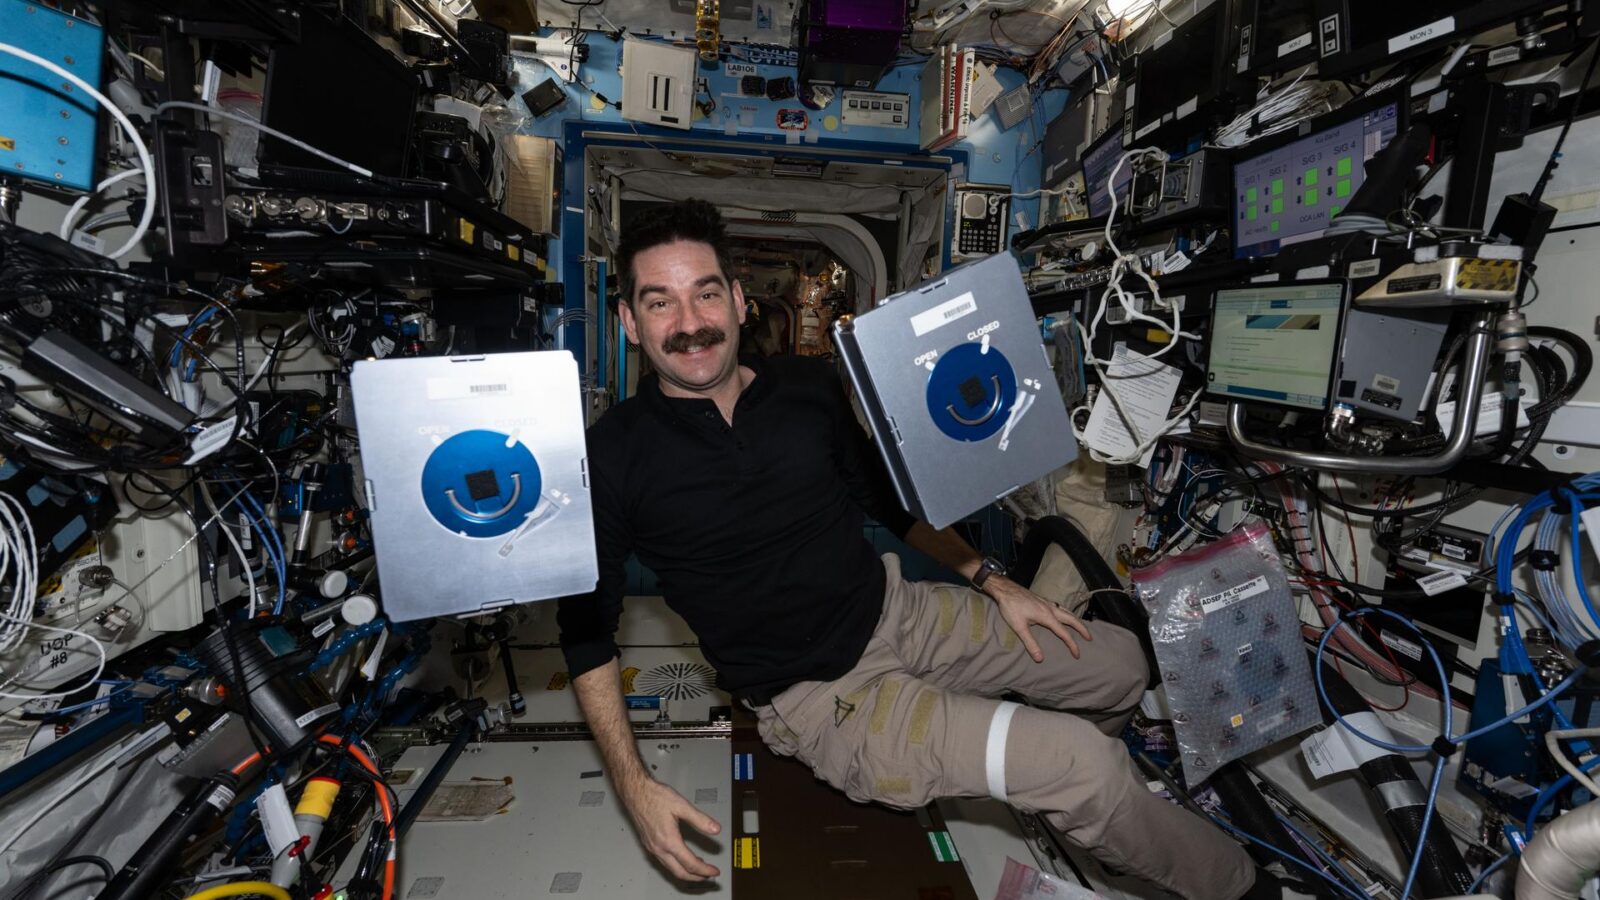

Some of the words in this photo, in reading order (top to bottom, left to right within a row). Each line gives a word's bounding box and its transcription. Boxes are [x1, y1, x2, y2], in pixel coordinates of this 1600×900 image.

[1409, 31, 1427, 42] MON
[949, 65, 957, 114] WARNING
[1334, 143, 1348, 155] SIG
[1302, 154, 1316, 165] SIG
[967, 320, 1000, 341] CLOSED
[914, 349, 938, 366] OPEN
[1202, 594, 1222, 606] ADSEP
[1233, 582, 1256, 595] Cassette
[50, 652, 68, 668] #8
